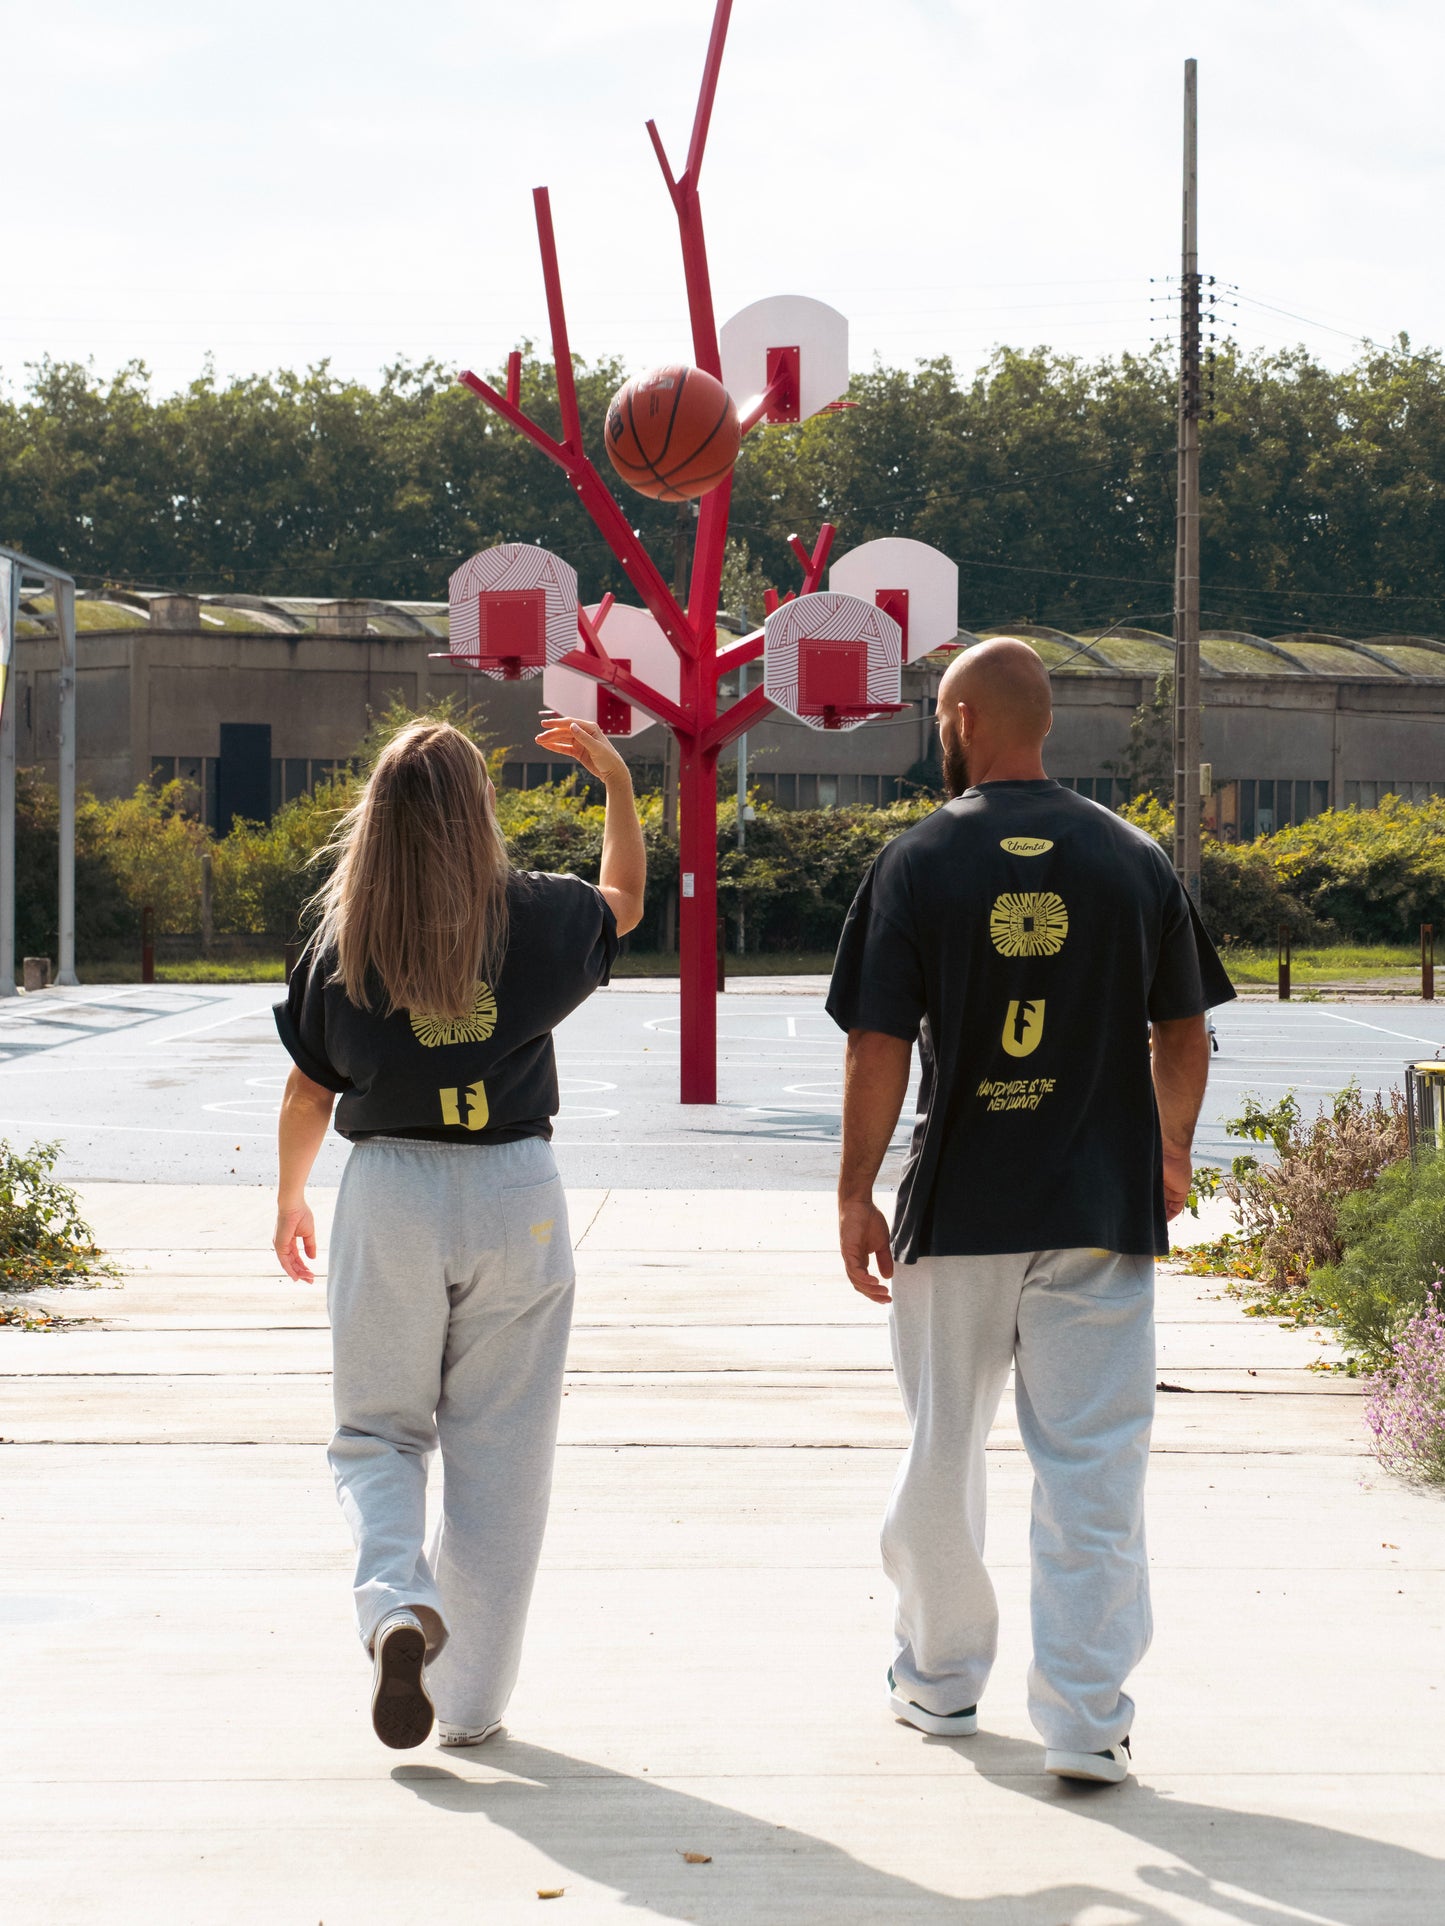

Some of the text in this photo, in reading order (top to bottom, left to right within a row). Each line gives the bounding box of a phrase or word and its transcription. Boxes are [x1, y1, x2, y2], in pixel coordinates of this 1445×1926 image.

[1028, 1079, 1040, 1093] IS
[1039, 1079, 1057, 1092] THE
[986, 1097, 1008, 1112] NEW
